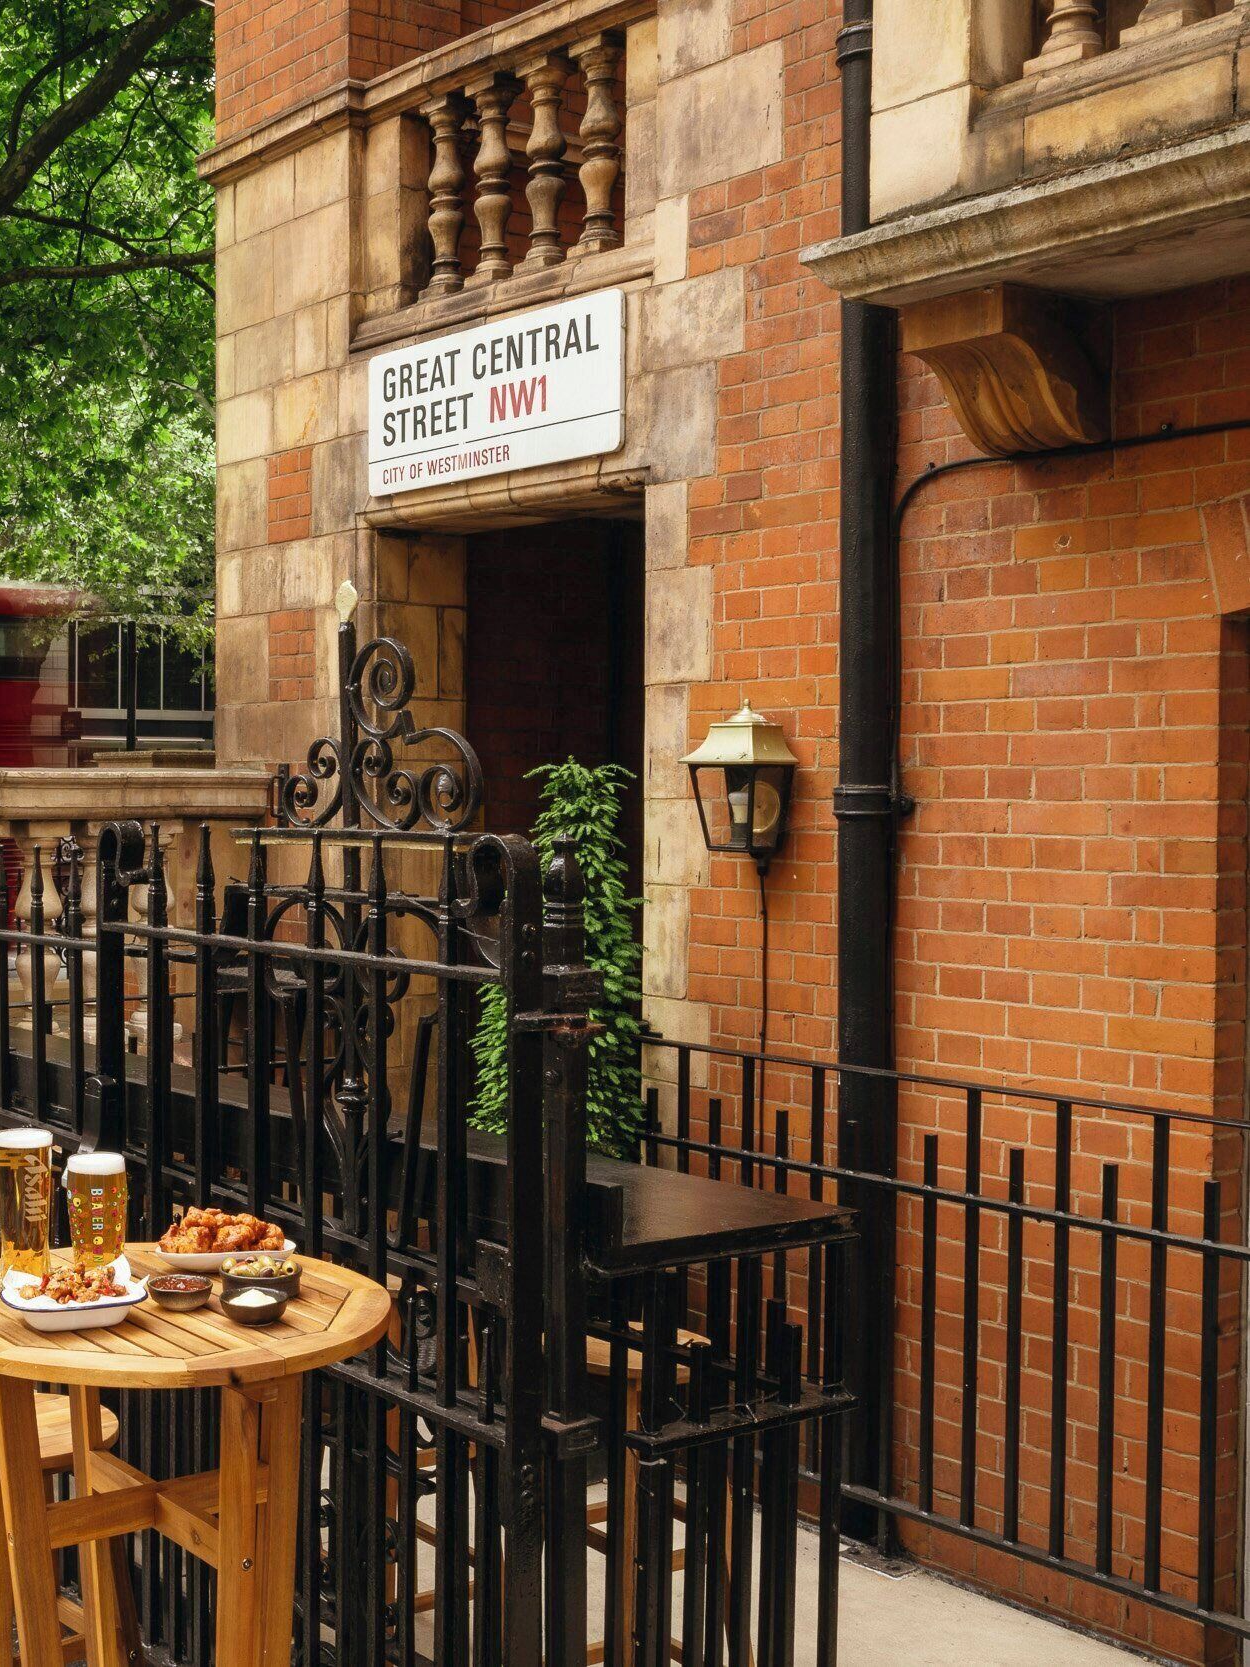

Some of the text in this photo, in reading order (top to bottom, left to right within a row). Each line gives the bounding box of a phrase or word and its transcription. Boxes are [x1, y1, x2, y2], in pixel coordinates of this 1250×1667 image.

[383, 313, 600, 403] GREAT CENTRAL
[382, 375, 547, 447] STREET NW1
[382, 444, 510, 485] CITY OF WESTMINSTER
[23, 1154, 48, 1222] Asahi
